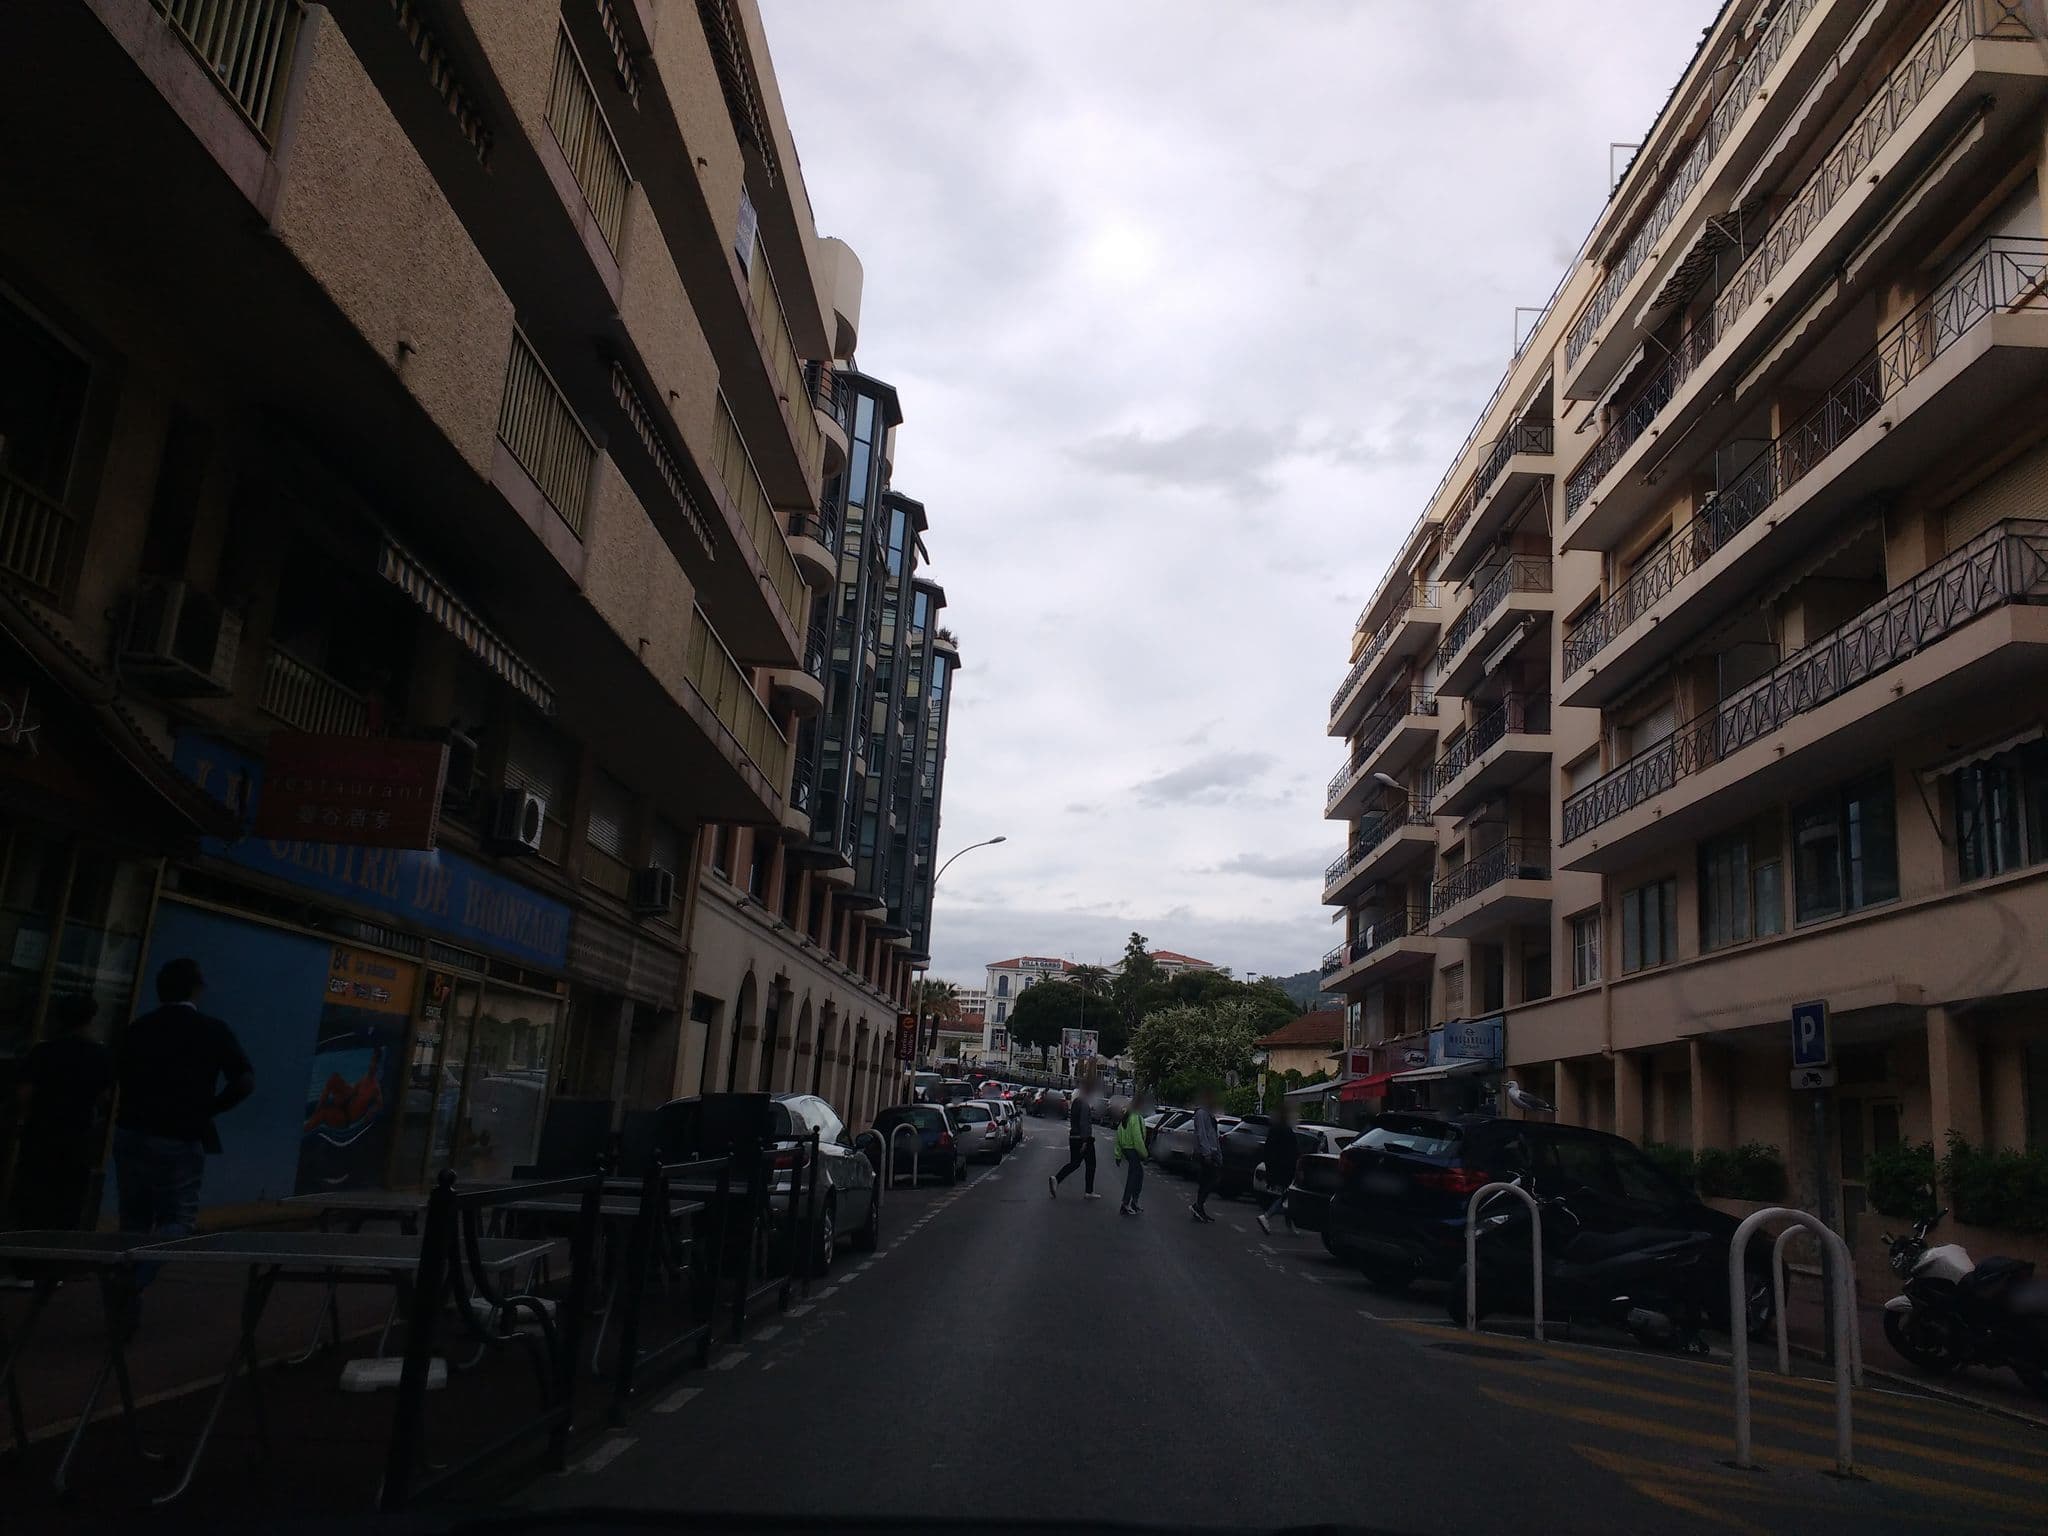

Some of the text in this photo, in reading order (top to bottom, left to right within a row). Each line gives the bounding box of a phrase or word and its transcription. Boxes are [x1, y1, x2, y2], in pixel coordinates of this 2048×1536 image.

[271, 776, 424, 800] restaurant
[413, 860, 453, 917] DE
[464, 878, 562, 955] BRONZAGE
[1800, 1016, 1816, 1054] P
